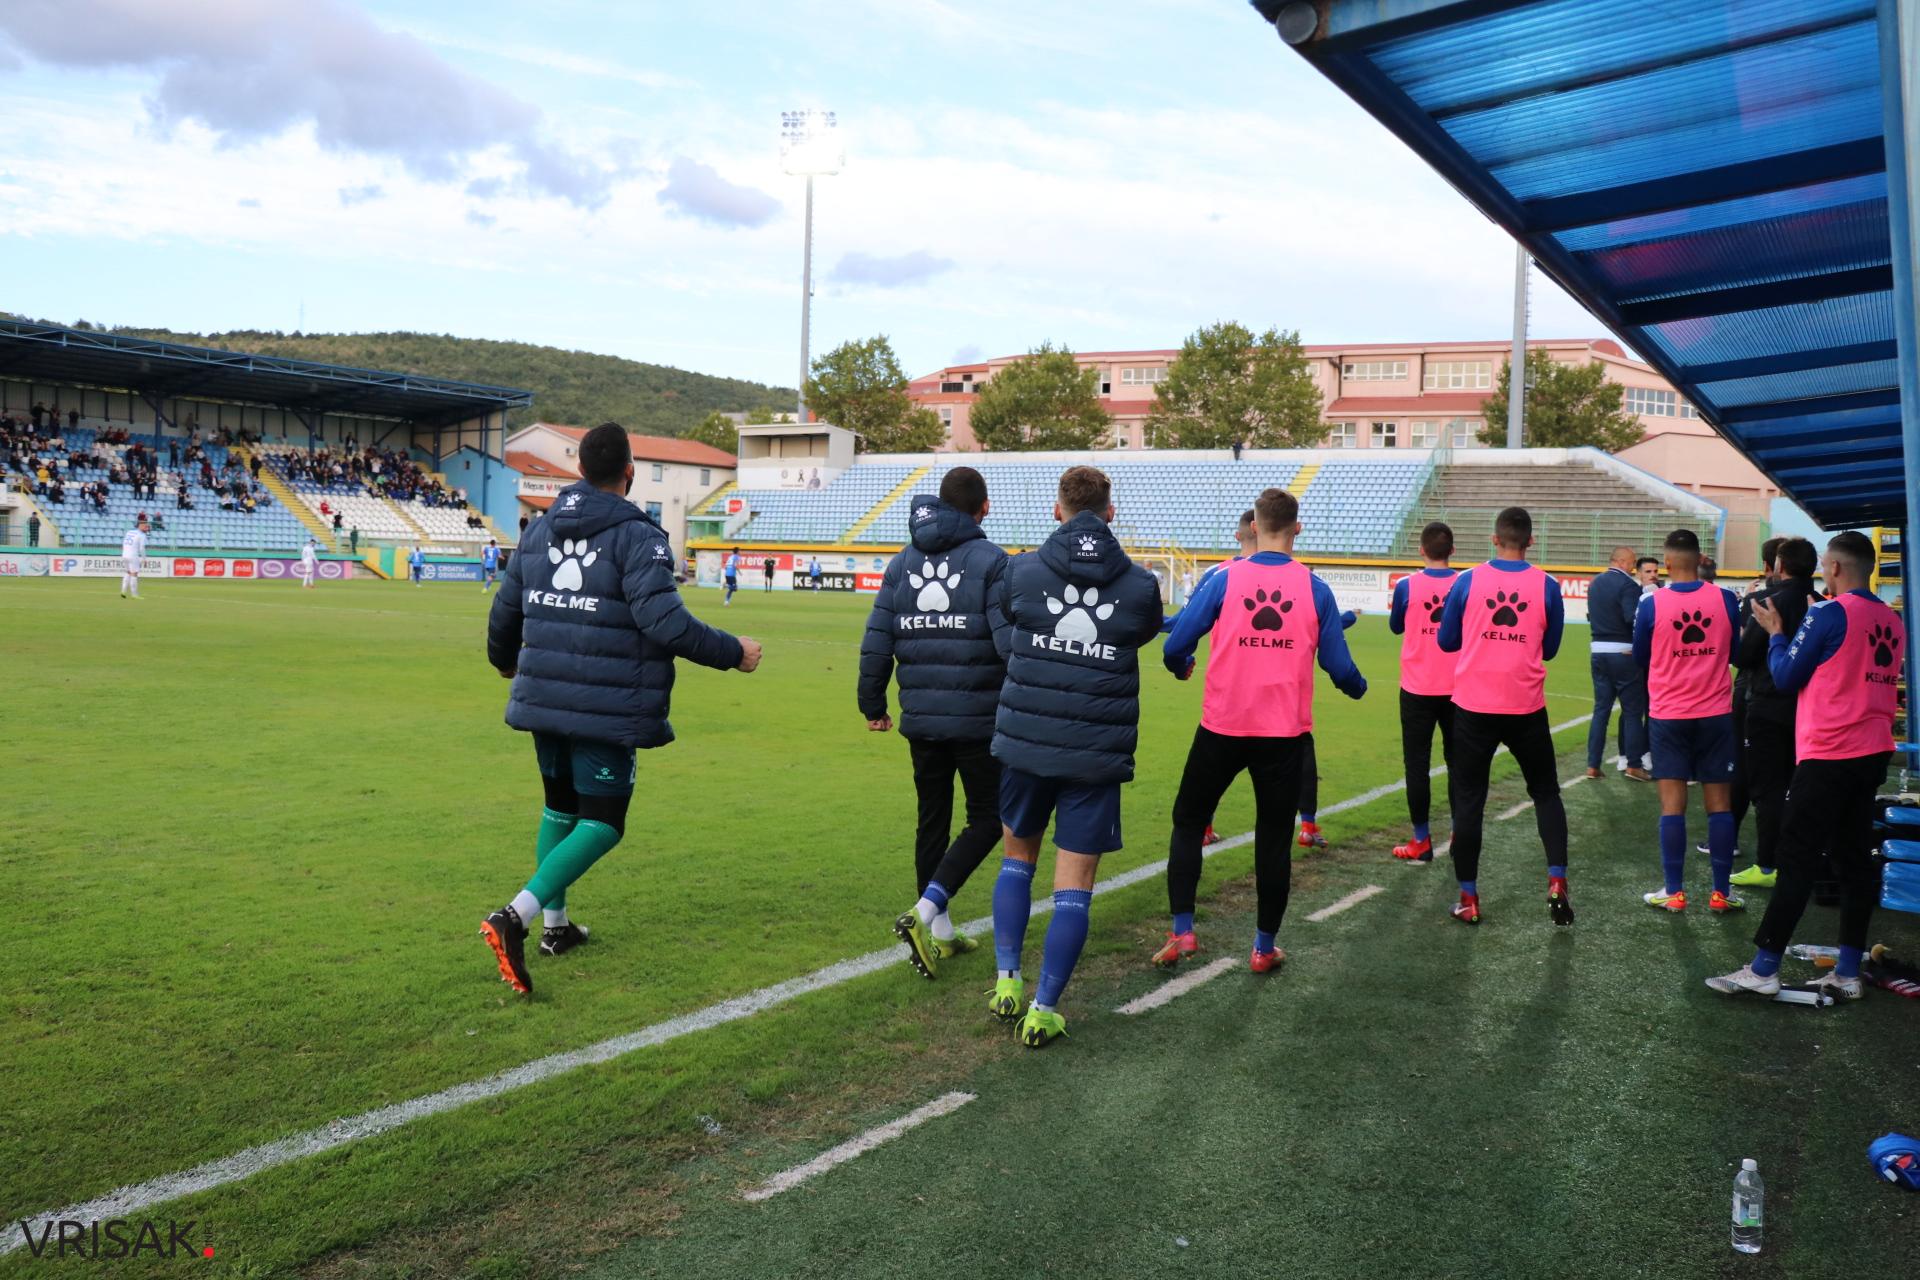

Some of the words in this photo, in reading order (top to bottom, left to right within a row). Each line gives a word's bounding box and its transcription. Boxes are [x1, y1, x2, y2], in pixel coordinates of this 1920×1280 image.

[794, 576, 843, 589] KEME
[528, 590, 599, 612] KELME
[900, 615, 967, 630] KELME
[1239, 636, 1294, 649] KELME
[1481, 631, 1527, 643] KELME
[1032, 633, 1117, 661] KELME
[1673, 647, 1717, 658] KELME
[1865, 671, 1898, 686] KELME
